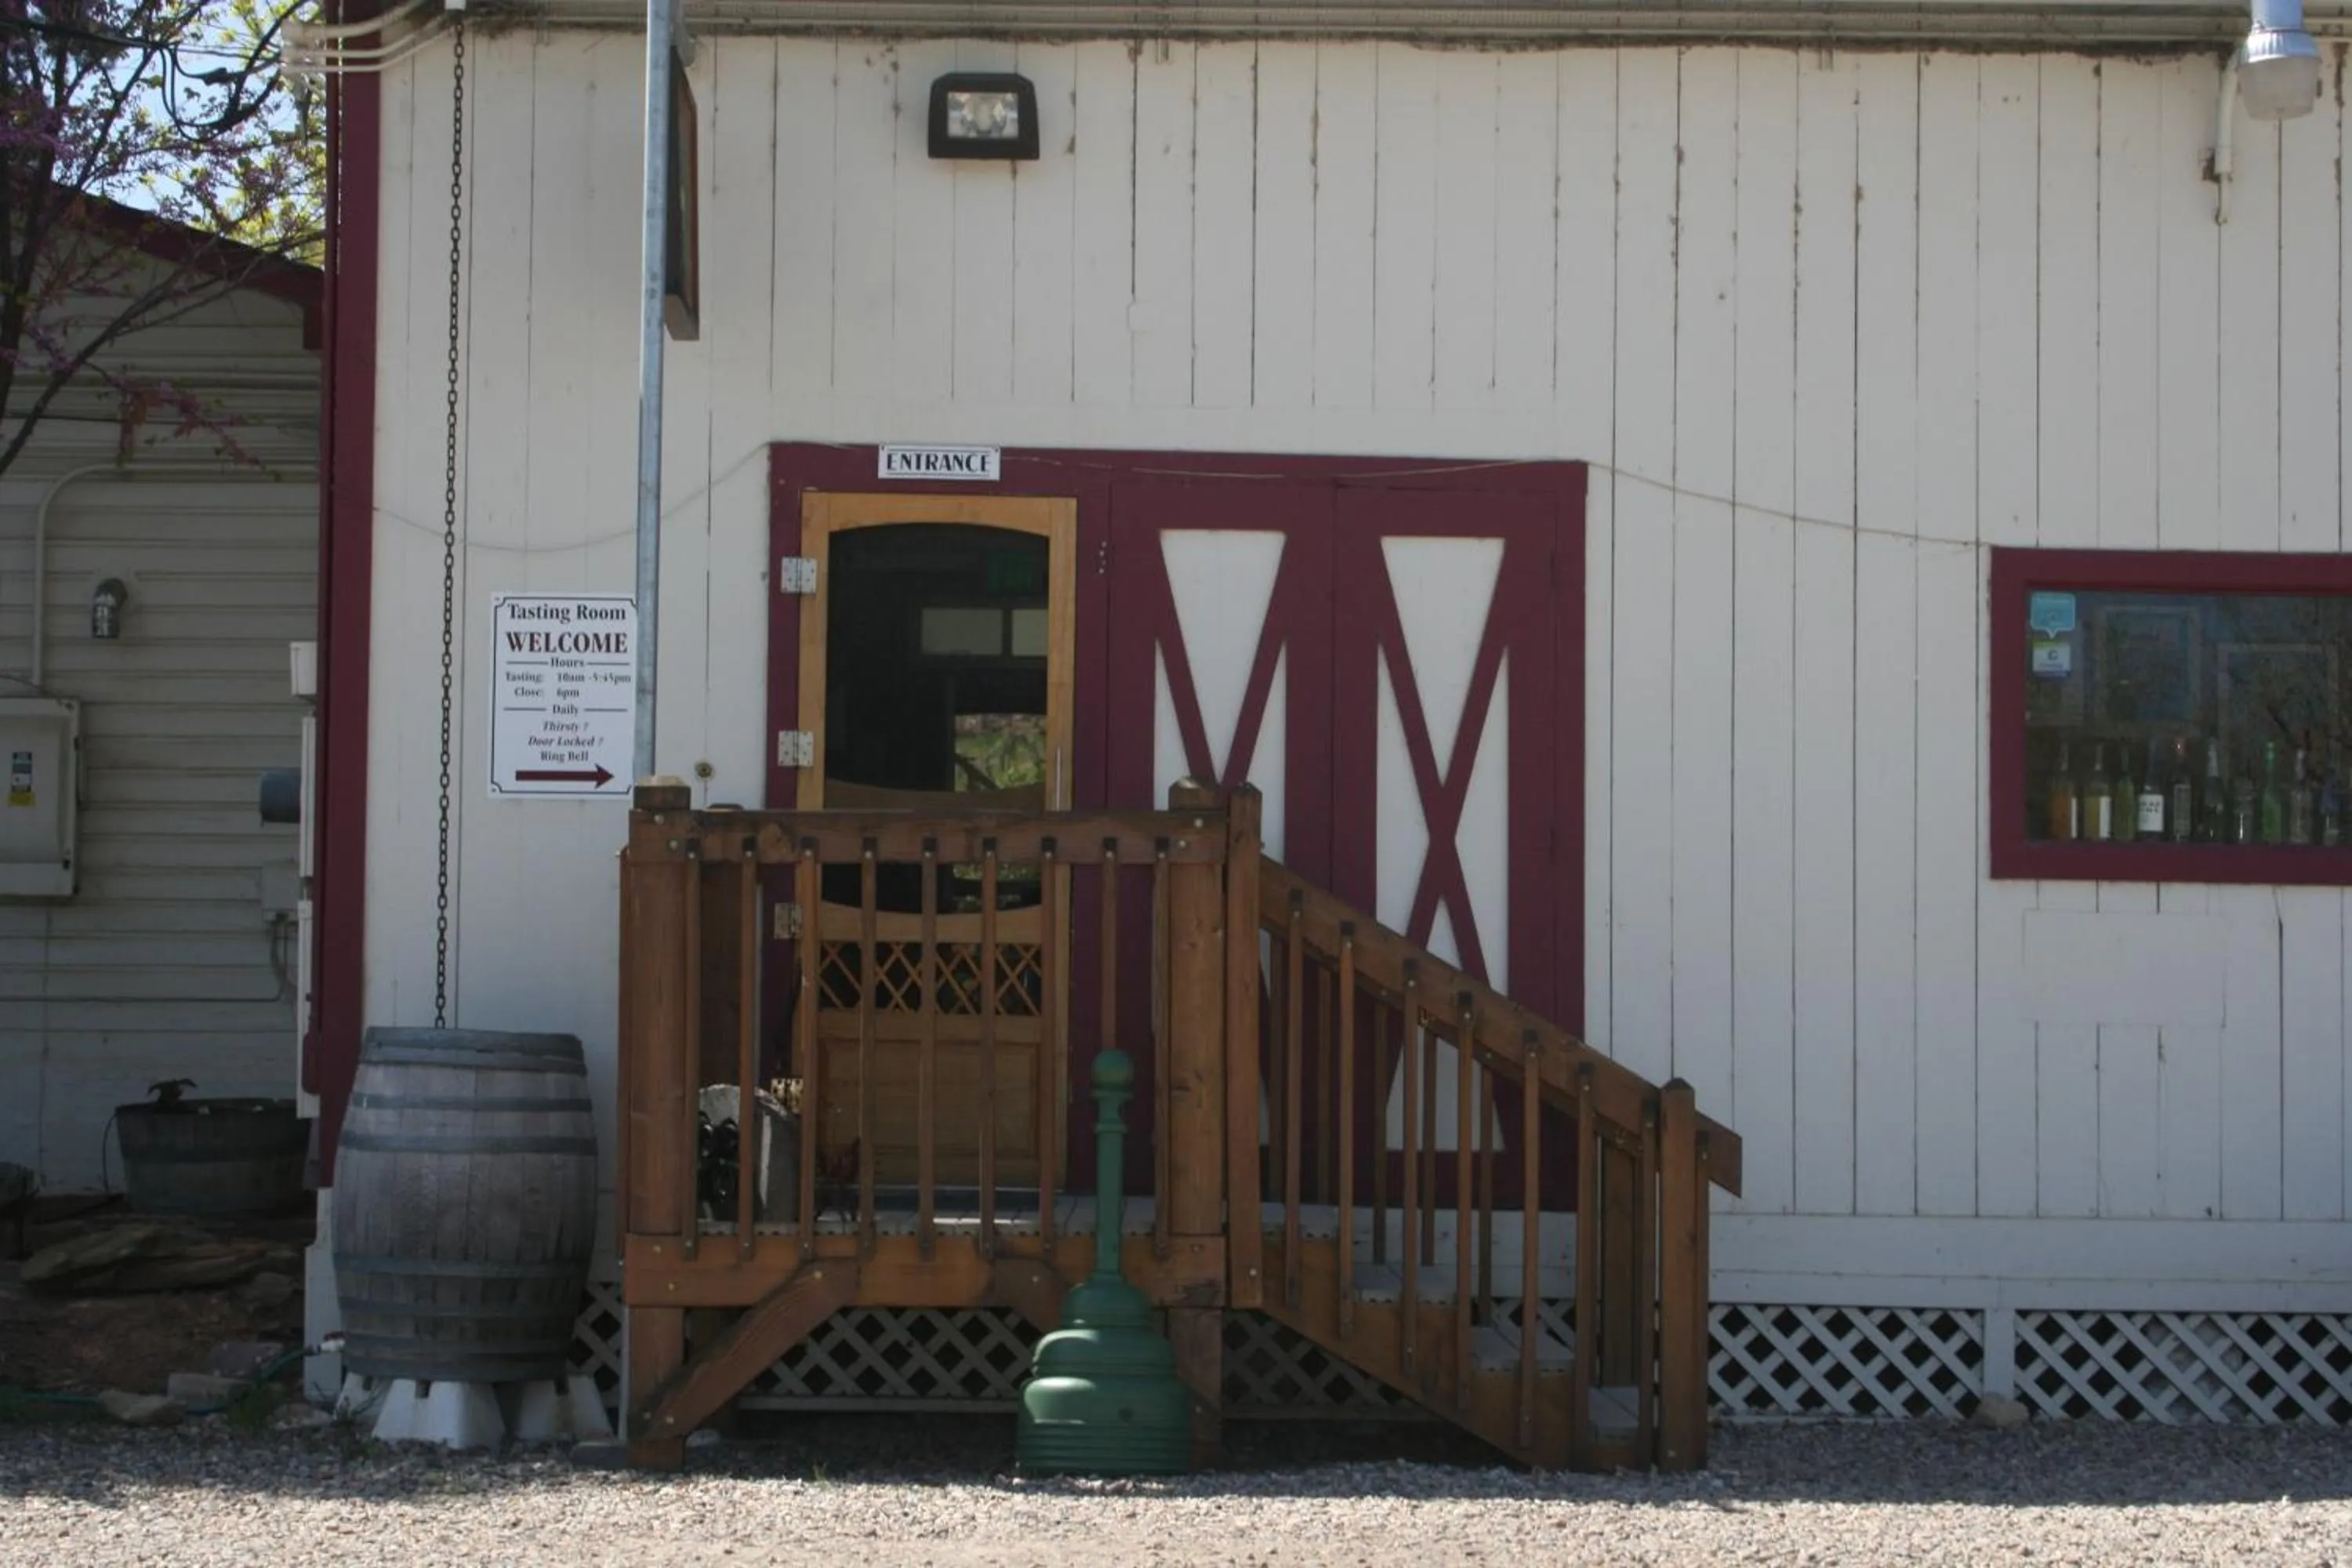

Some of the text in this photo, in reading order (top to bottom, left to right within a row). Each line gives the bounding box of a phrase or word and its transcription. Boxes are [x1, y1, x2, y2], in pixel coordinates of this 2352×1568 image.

[887, 452, 992, 472] ENTRANCE
[508, 603, 626, 624] Tasting Room
[506, 631, 628, 654] WELCOME
[550, 657, 585, 668] Hours
[557, 673, 585, 682] 10am
[557, 688, 579, 699] 6pm
[552, 704, 579, 716] Daily
[528, 736, 554, 747] Door
[557, 735, 595, 747] Locked
[540, 751, 589, 762] Ring Bell
